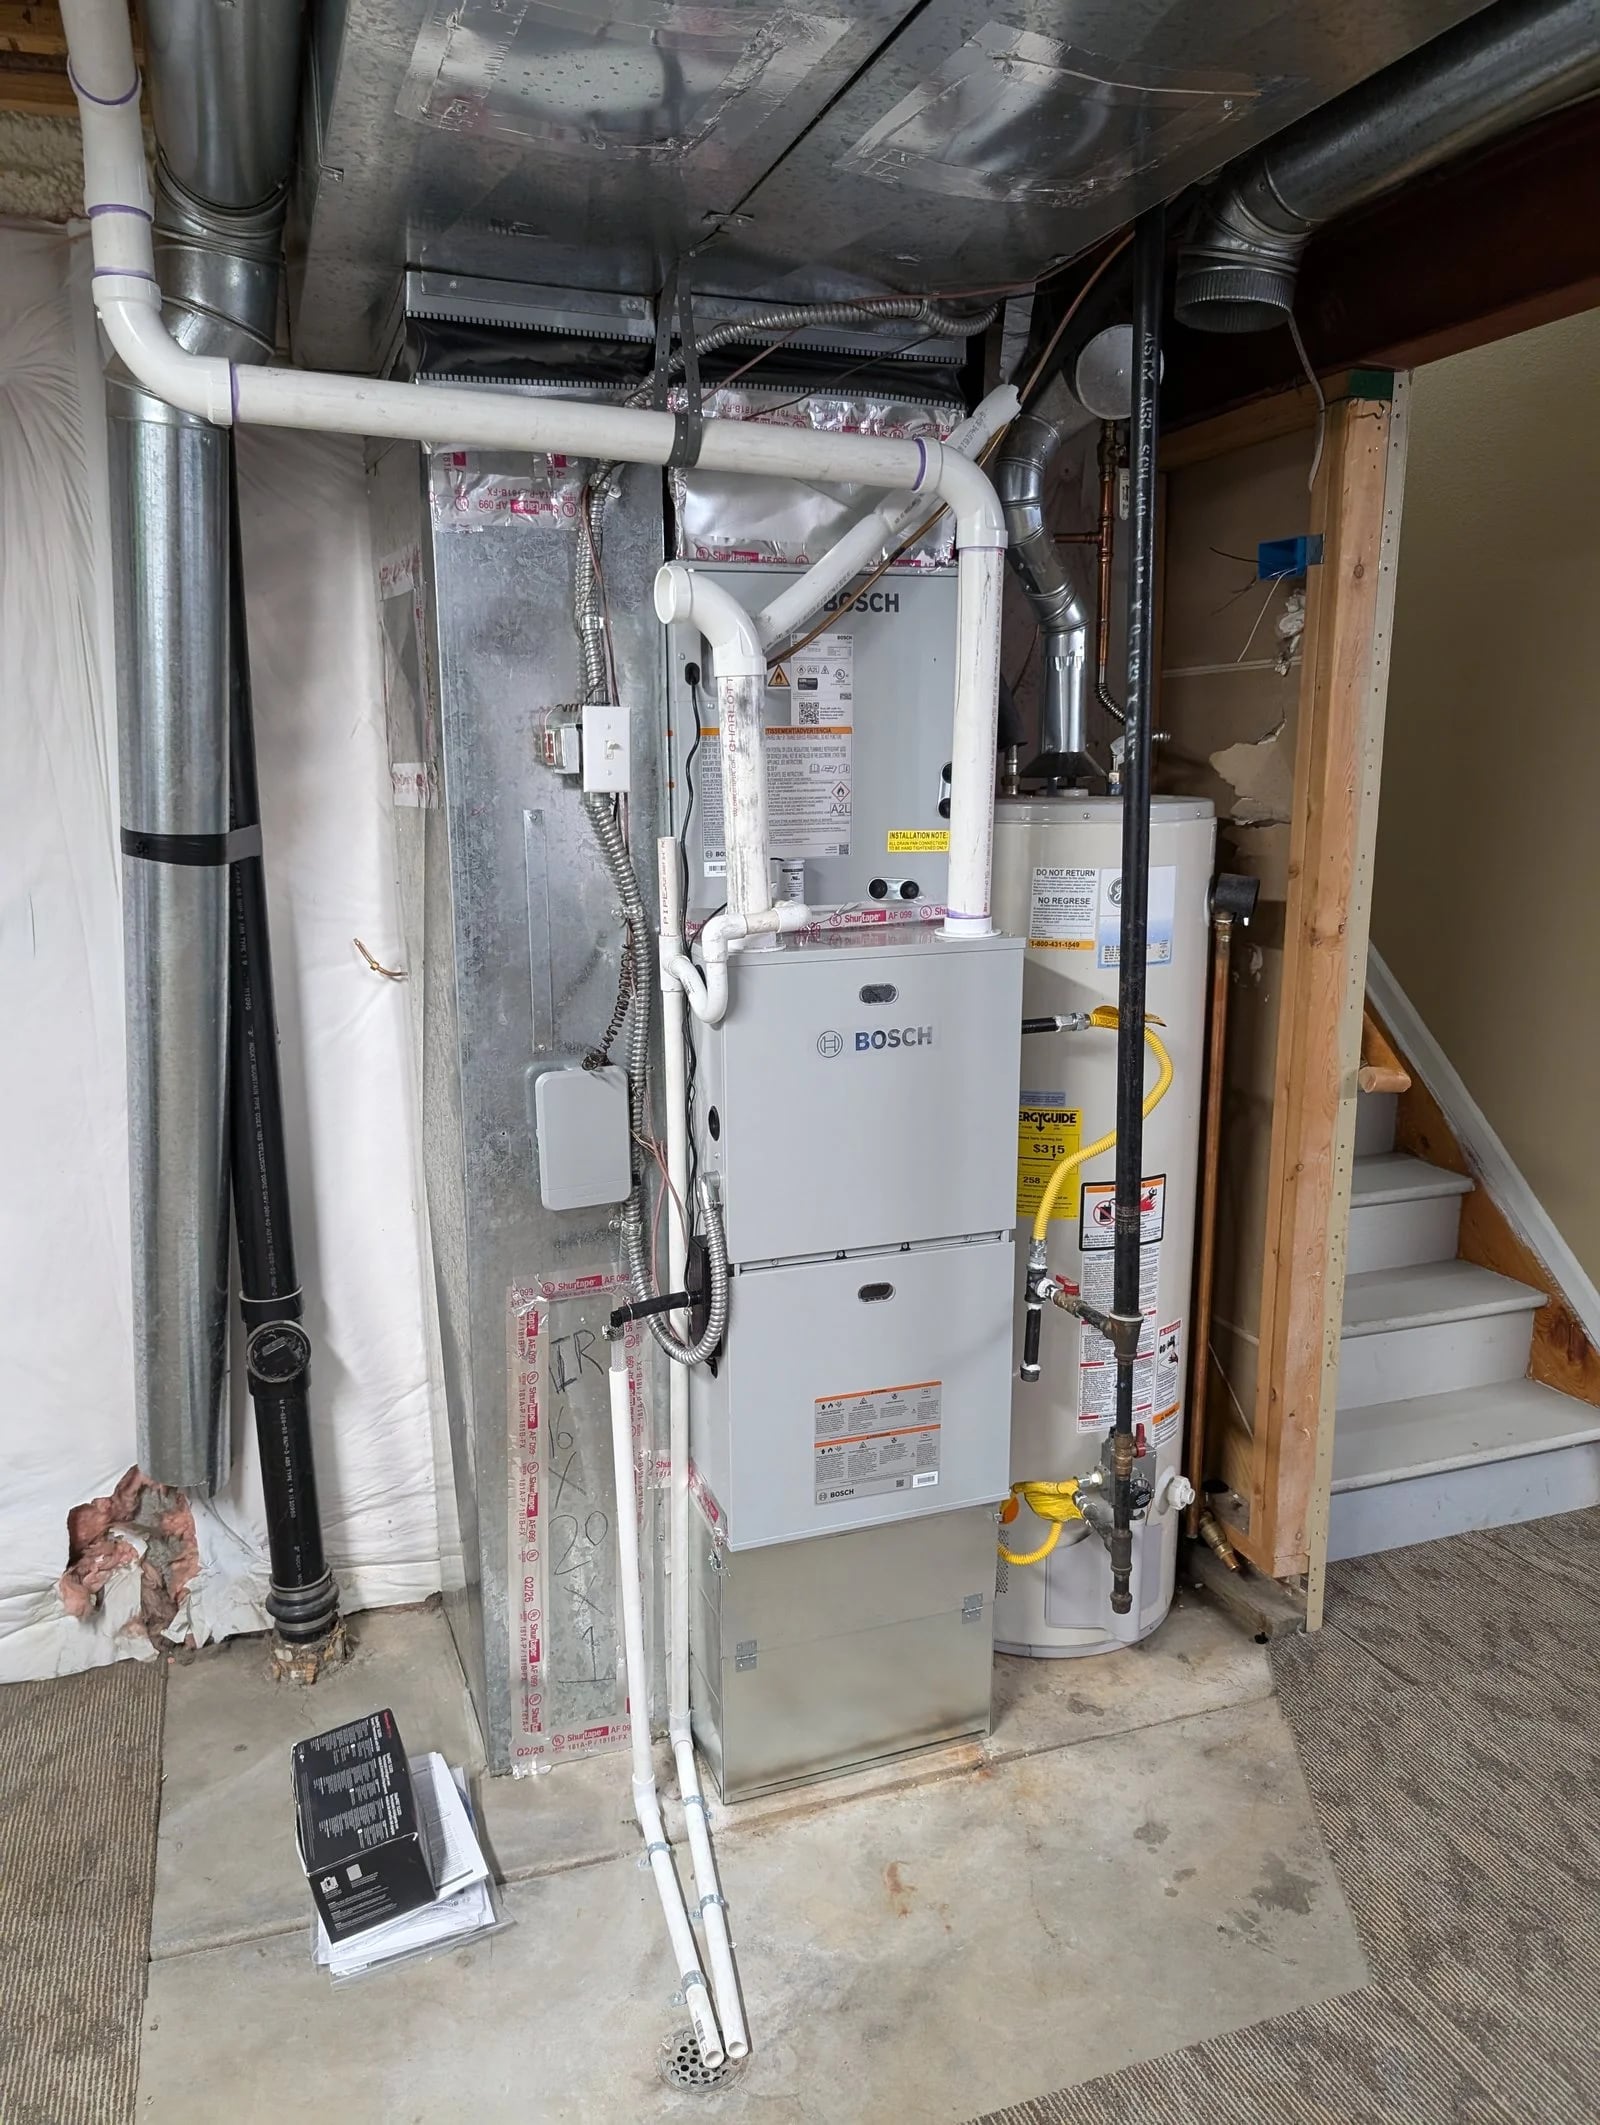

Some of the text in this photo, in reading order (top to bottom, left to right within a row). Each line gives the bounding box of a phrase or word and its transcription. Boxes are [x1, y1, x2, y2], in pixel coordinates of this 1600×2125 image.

[1141, 332, 1155, 381] ASTM
[478, 499, 494, 509] 099
[824, 592, 900, 613] BOSCH
[725, 677, 737, 753] CHARLOTT
[831, 803, 850, 814] A2L
[889, 831, 930, 839] INSTALLATION
[1066, 869, 1096, 877] RETURN
[1038, 896, 1091, 905] NO REGRESE
[844, 910, 886, 923] Shurtape
[888, 911, 898, 920] AF
[899, 910, 913, 919] 099
[855, 1026, 933, 1051] BOSCH
[1019, 1111, 1077, 1124] ERGYGUIDE
[1033, 1144, 1065, 1154] $315
[1023, 1176, 1041, 1184] 258
[558, 1275, 602, 1291] Shurtape
[604, 1276, 615, 1285] AF
[616, 1274, 630, 1282] 099
[527, 1339, 537, 1351] AF
[528, 1351, 537, 1365] 099
[527, 1386, 538, 1429] Shurtape
[527, 1430, 537, 1442] AF
[527, 1442, 537, 1455] 099
[527, 1477, 538, 1518] Shurtape
[830, 1488, 855, 1498] BOSCH
[527, 1520, 537, 1530] AF
[528, 1530, 537, 1543] 099
[548, 1510, 609, 1576] 20
[523, 1576, 535, 1603] Q2/26
[528, 1623, 540, 1663] Shurtape
[530, 1665, 538, 1674] AF
[567, 1726, 609, 1742] Shurtape
[611, 1725, 622, 1733] AF
[622, 1724, 632, 1733] 09
[517, 1745, 545, 1757] Q2/26
